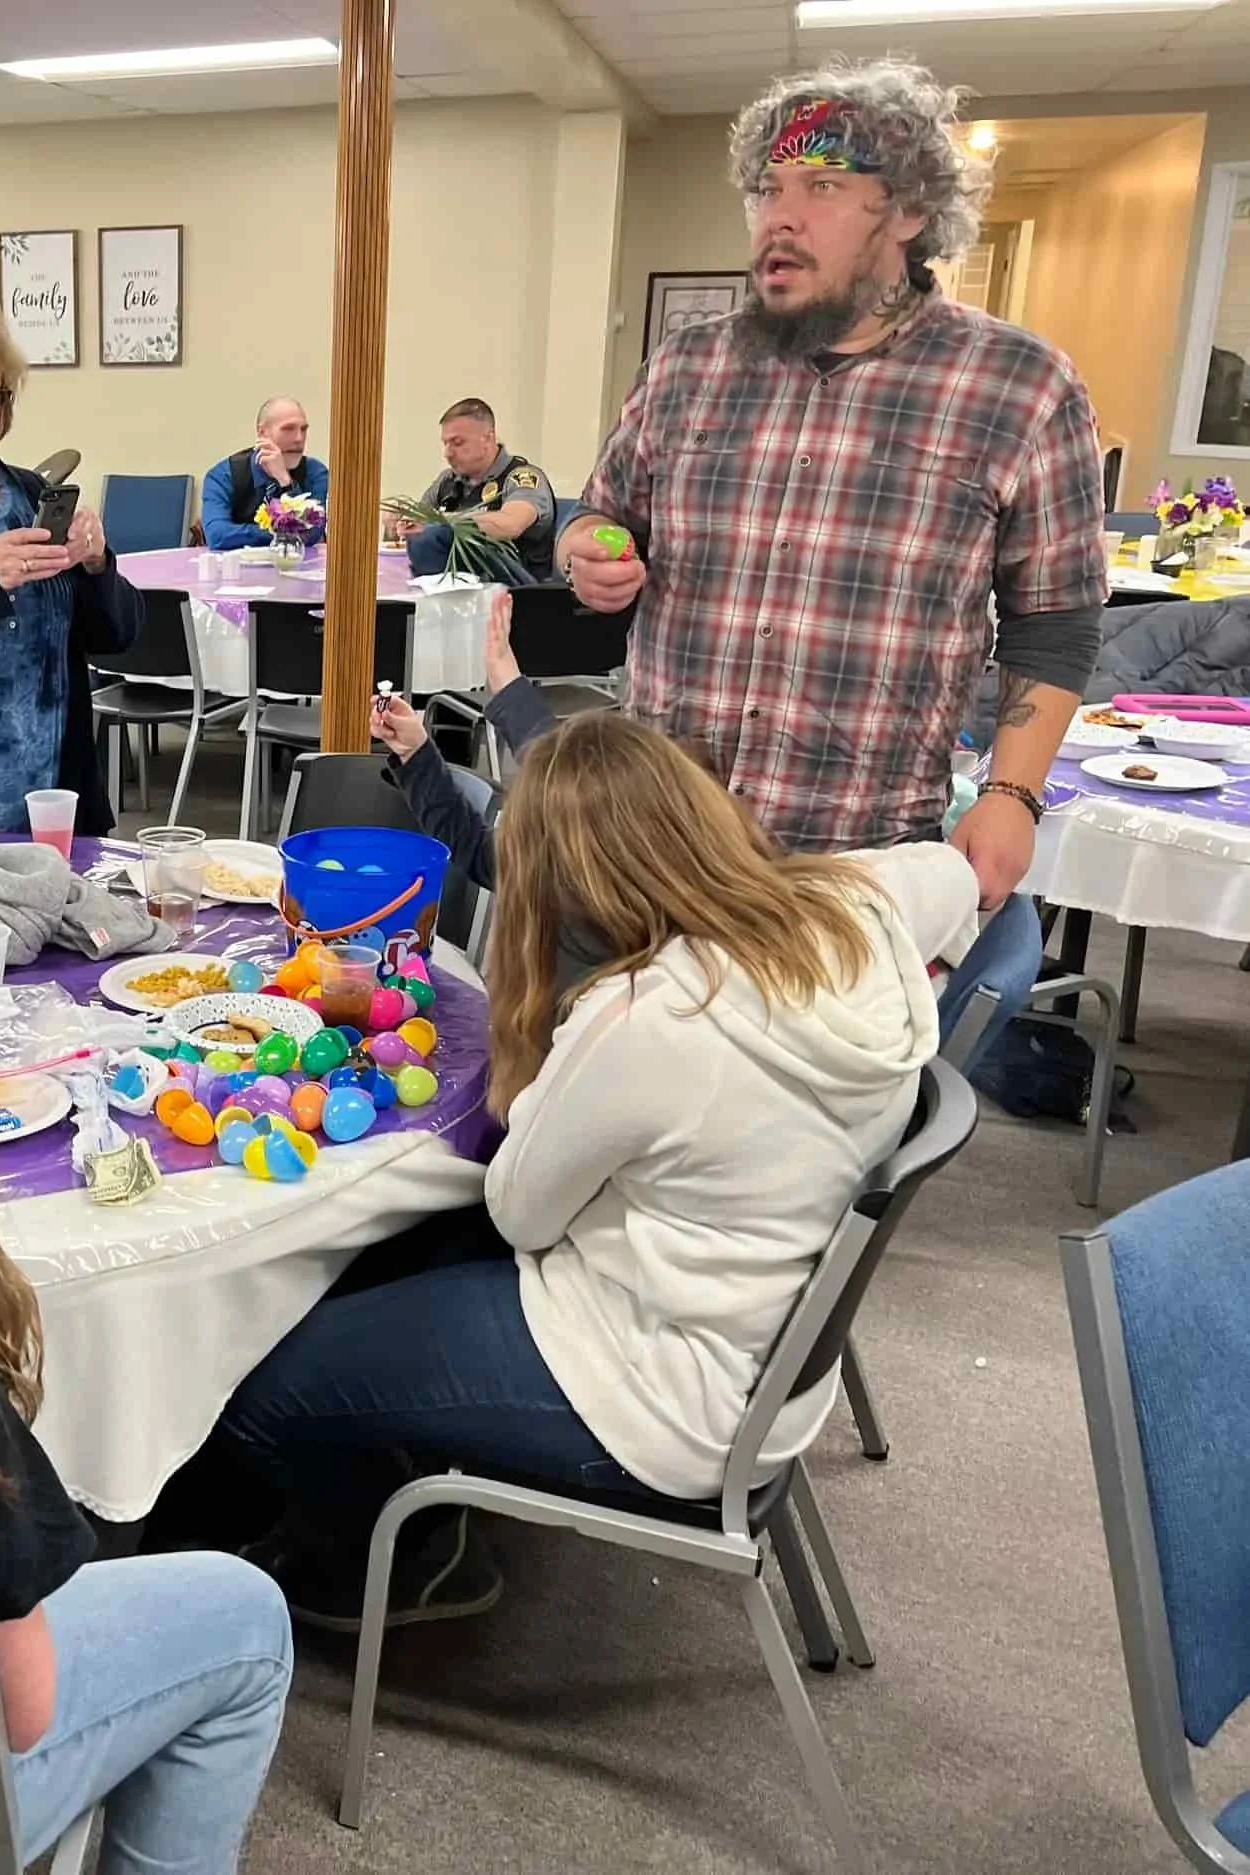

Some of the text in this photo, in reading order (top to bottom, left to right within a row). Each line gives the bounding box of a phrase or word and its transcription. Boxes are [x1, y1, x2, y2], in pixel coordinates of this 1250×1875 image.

[121, 271, 140, 279] AND
[12, 281, 67, 320] family
[124, 280, 159, 311] love
